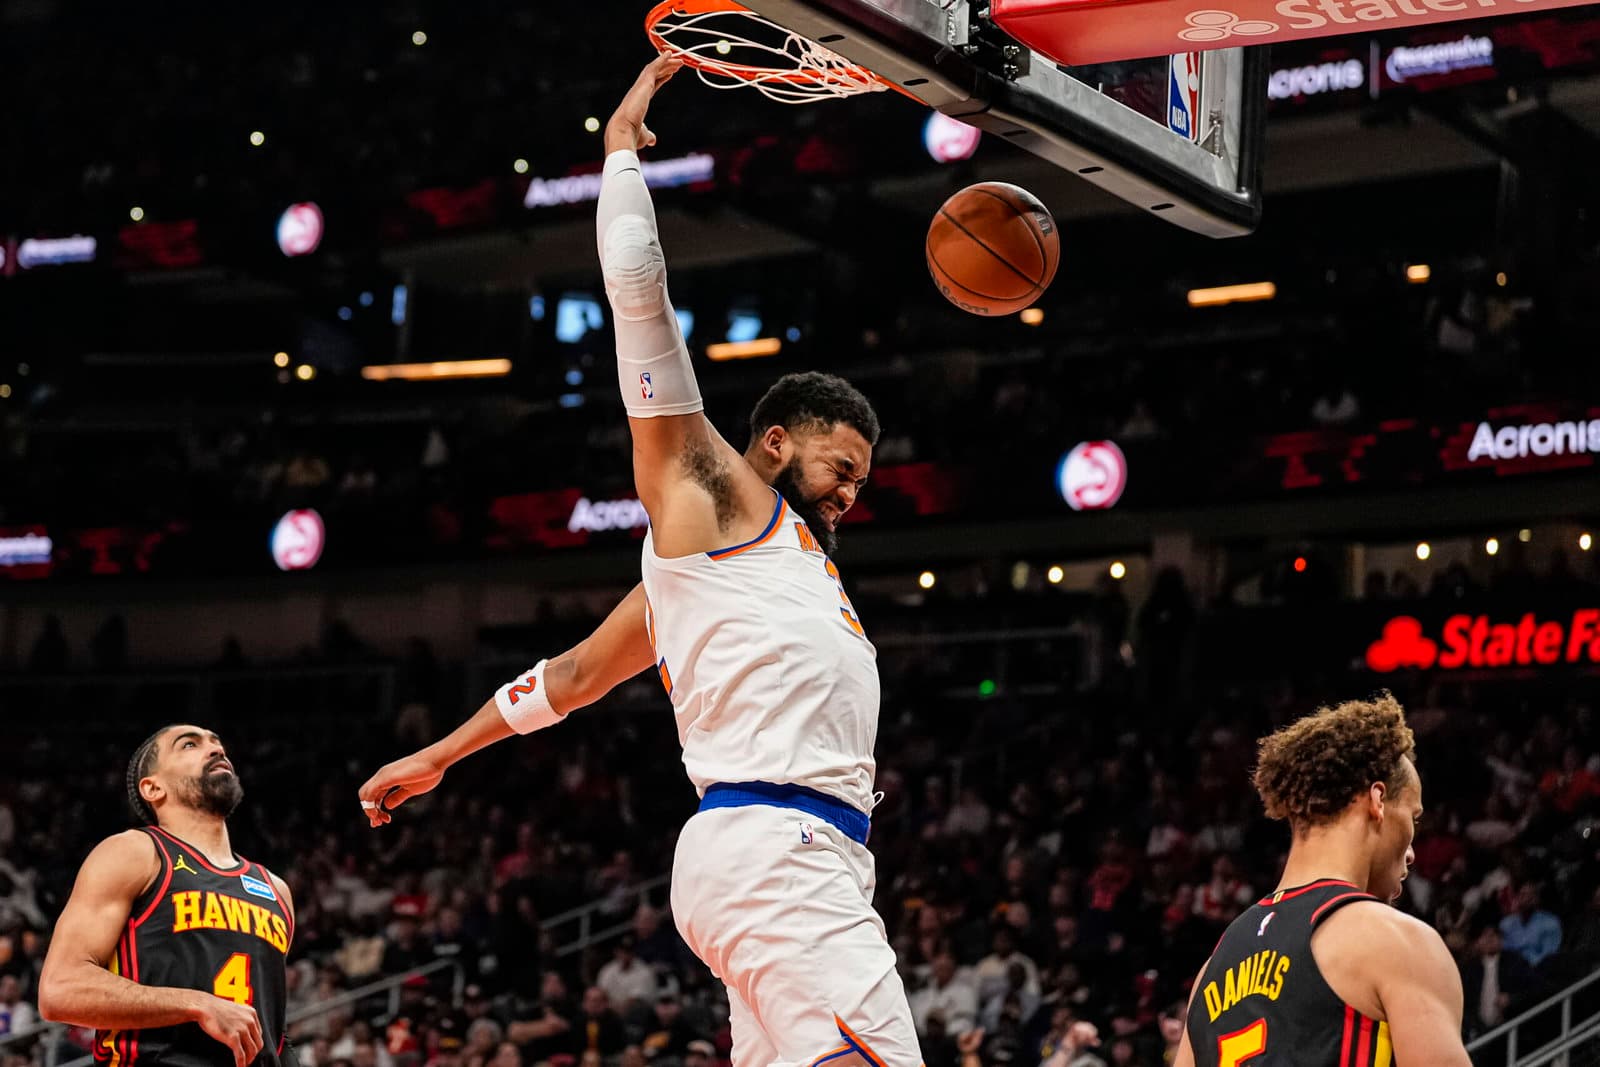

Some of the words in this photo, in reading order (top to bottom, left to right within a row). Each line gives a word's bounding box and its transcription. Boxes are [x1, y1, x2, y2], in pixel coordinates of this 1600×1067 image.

[1268, 58, 1364, 99] cronis
[567, 497, 650, 533] Acro
[1438, 611, 1564, 669] State
[171, 890, 288, 955] HAWKS
[213, 952, 253, 1006] 4
[1203, 949, 1291, 1024] DANIELS
